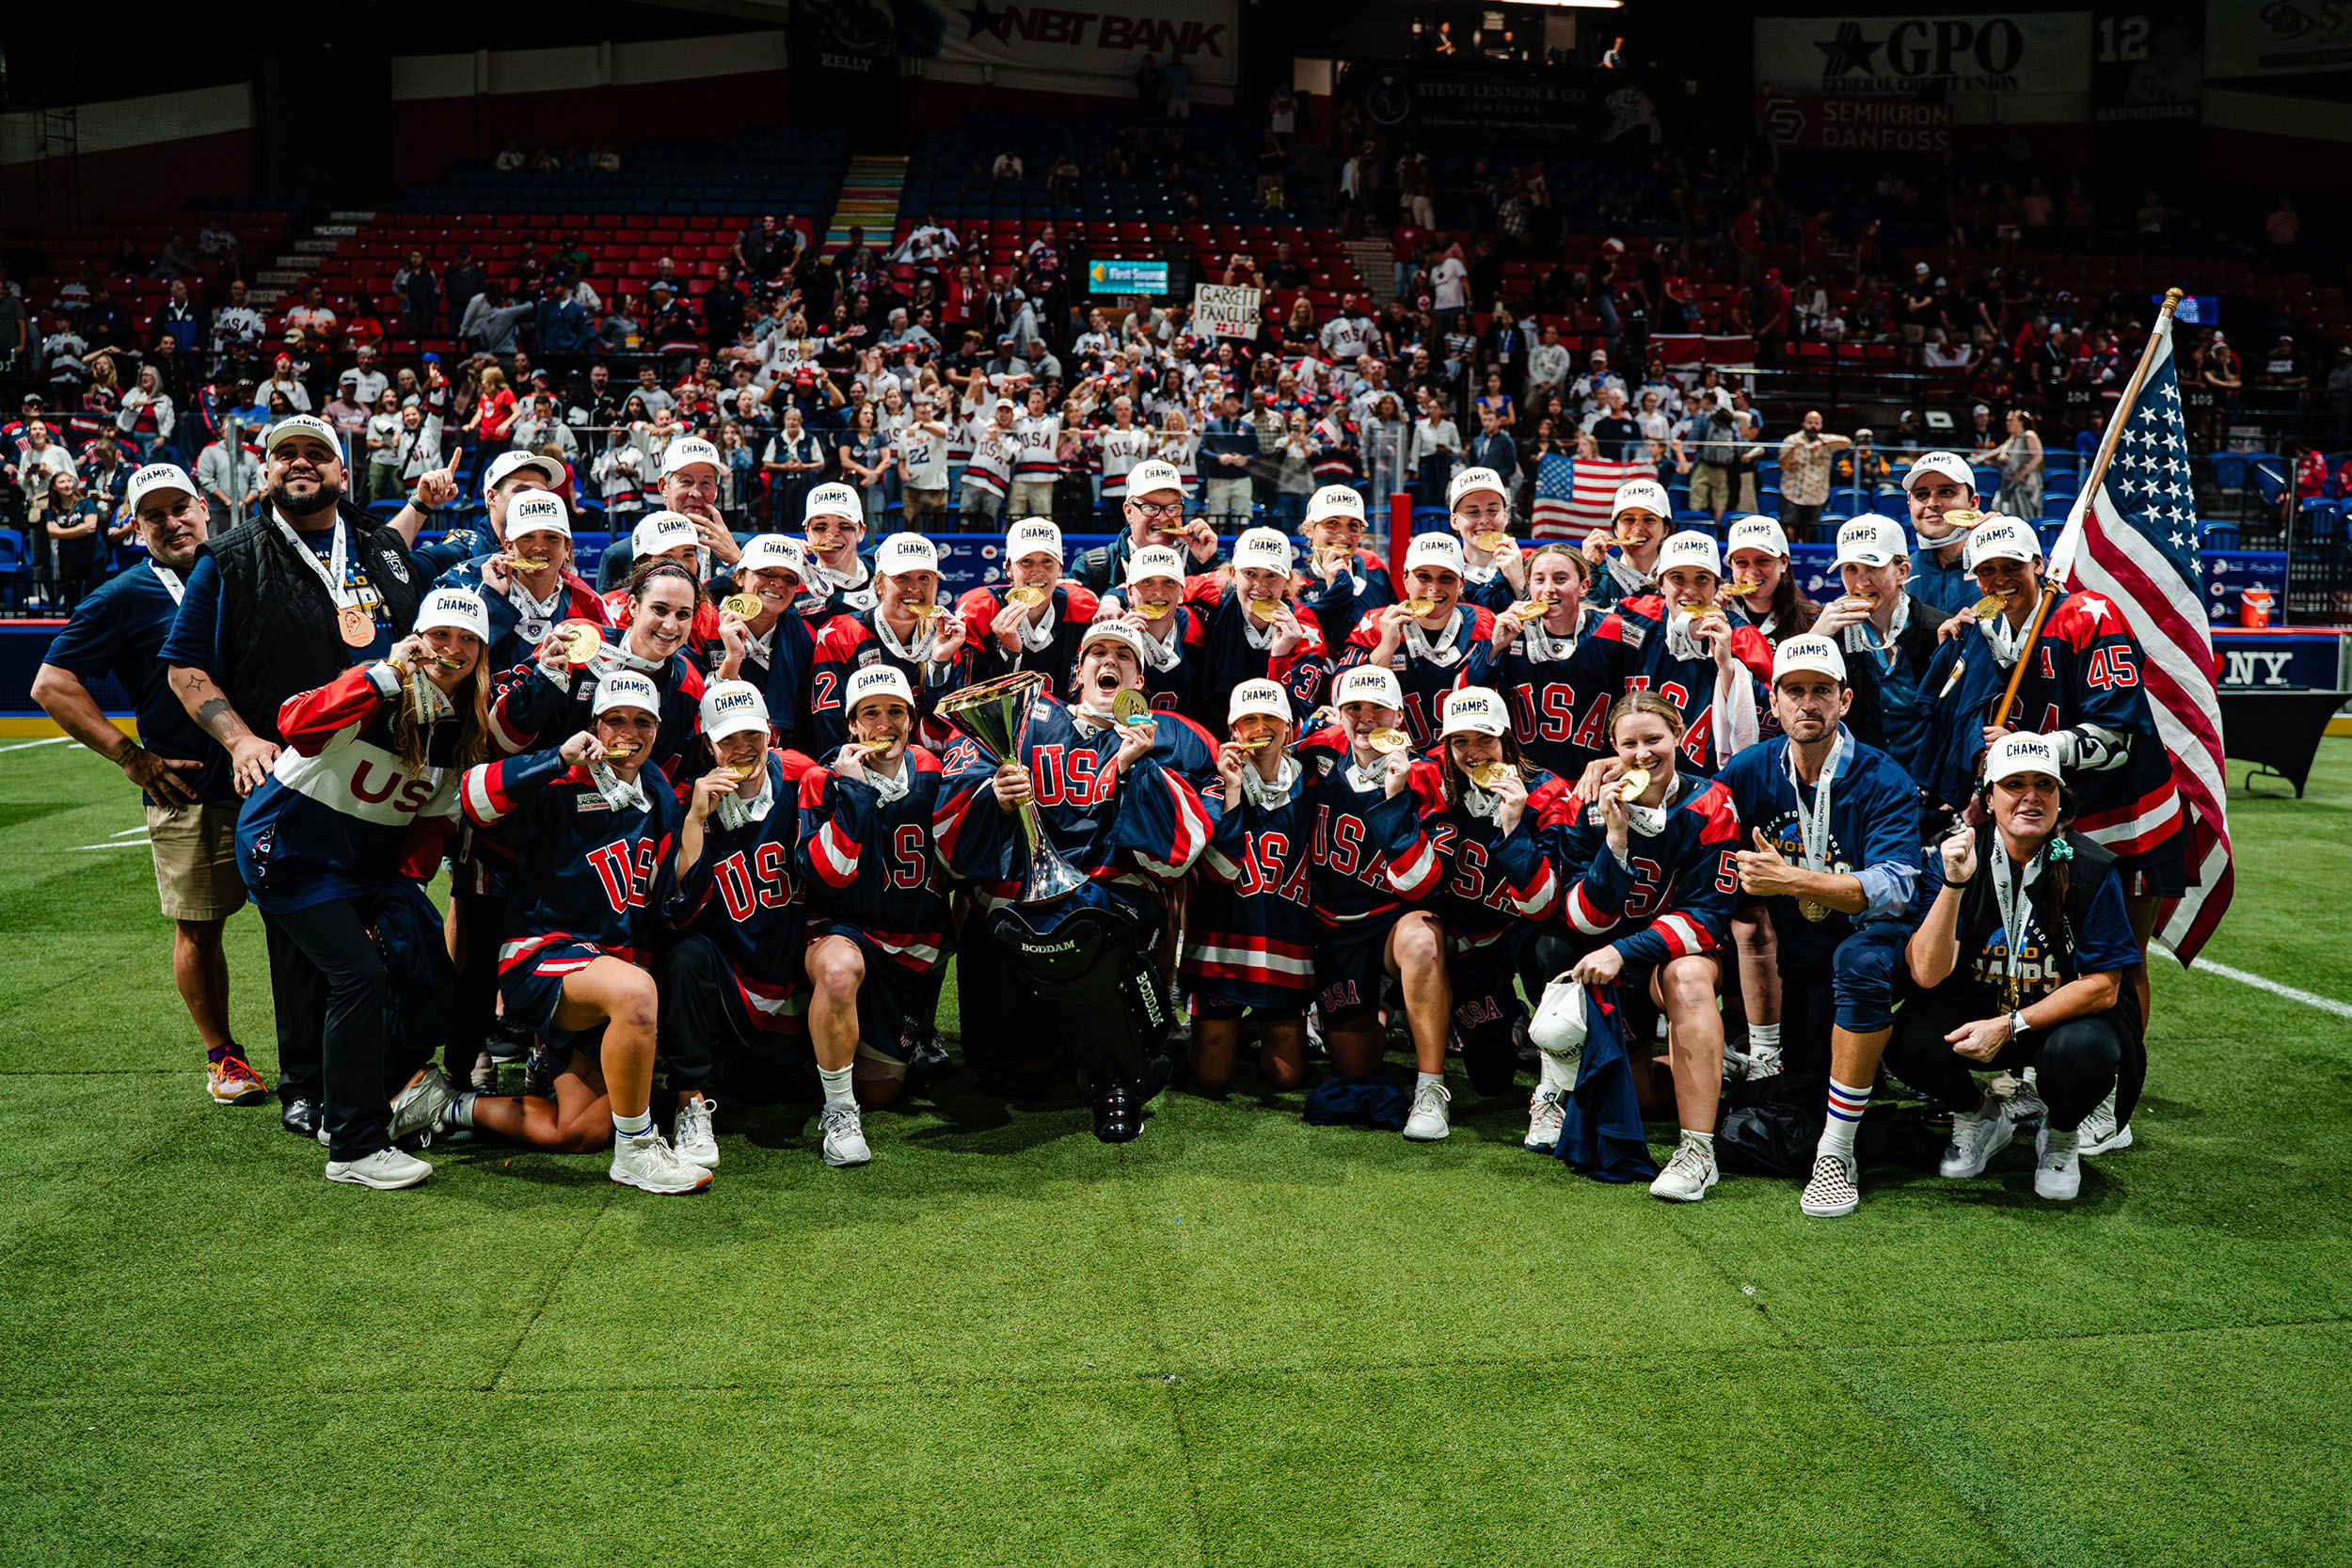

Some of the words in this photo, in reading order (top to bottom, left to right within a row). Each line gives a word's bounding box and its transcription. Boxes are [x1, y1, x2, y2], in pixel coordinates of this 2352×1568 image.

[1001, 3, 1096, 45] NBT
[1098, 15, 1226, 58] BANK
[2097, 15, 2151, 63] 12
[1886, 19, 2023, 77] GPO
[820, 53, 873, 72] KELLY
[1821, 100, 1951, 127] SEMIKRON
[1821, 126, 1951, 151] DANFOSS
[1200, 285, 1258, 307] GARRETT
[682, 444, 713, 458] CHAMPS
[909, 445, 930, 466] 22
[1917, 456, 1952, 469] CHAMPS
[136, 467, 175, 487] CHAMPS
[1145, 468, 1175, 481] CHAMPS
[1459, 473, 1492, 488] CHAMPS
[814, 492, 848, 505] CHAMPS
[1326, 495, 1358, 507] CHAMPS
[1623, 488, 1655, 499] CHAMPS
[519, 502, 558, 516] CHAMPS
[658, 520, 691, 534] CHAMPS
[1021, 528, 1055, 542] CHAMPS
[1738, 525, 1771, 536] CHAMPS
[1842, 528, 1877, 544] CHAMPS
[1976, 526, 2015, 547] CHAMPS
[763, 541, 799, 562] CHAMPS
[898, 544, 931, 558] CHAMPS
[1248, 539, 1282, 554] CHAMPS
[1421, 541, 1454, 554] CHAMPS
[1673, 542, 1709, 554] CHAMPS
[1142, 554, 1175, 566] CHAMPS
[437, 597, 479, 617] CHAMPS
[1098, 625, 1134, 638] CHAMPS
[1788, 645, 1828, 658] CHAMPS
[2040, 646, 2055, 679] A
[2087, 645, 2138, 691] 45
[2225, 651, 2293, 686] NY
[611, 679, 650, 696] CHAMPS
[857, 673, 897, 689] CHAMPS
[1349, 676, 1386, 689] CHAMPS
[715, 692, 755, 712] CHAMPS
[811, 671, 841, 715] 2
[1242, 689, 1278, 702] CHAMPS
[1452, 699, 1488, 716] CHAMPS
[1508, 682, 1612, 751] USA
[942, 738, 979, 778] 25
[2007, 743, 2050, 758] CHAMPS
[1032, 743, 1119, 807] USA
[350, 758, 435, 814] US
[1311, 803, 1395, 894] USA
[585, 836, 655, 915] US
[1232, 831, 1311, 908] USA
[712, 841, 793, 924] US
[1021, 939, 1075, 955] BODDAM
[1136, 970, 1165, 1028] BODDAM
[1320, 979, 1360, 1014] USA
[1455, 995, 1503, 1030] USA
